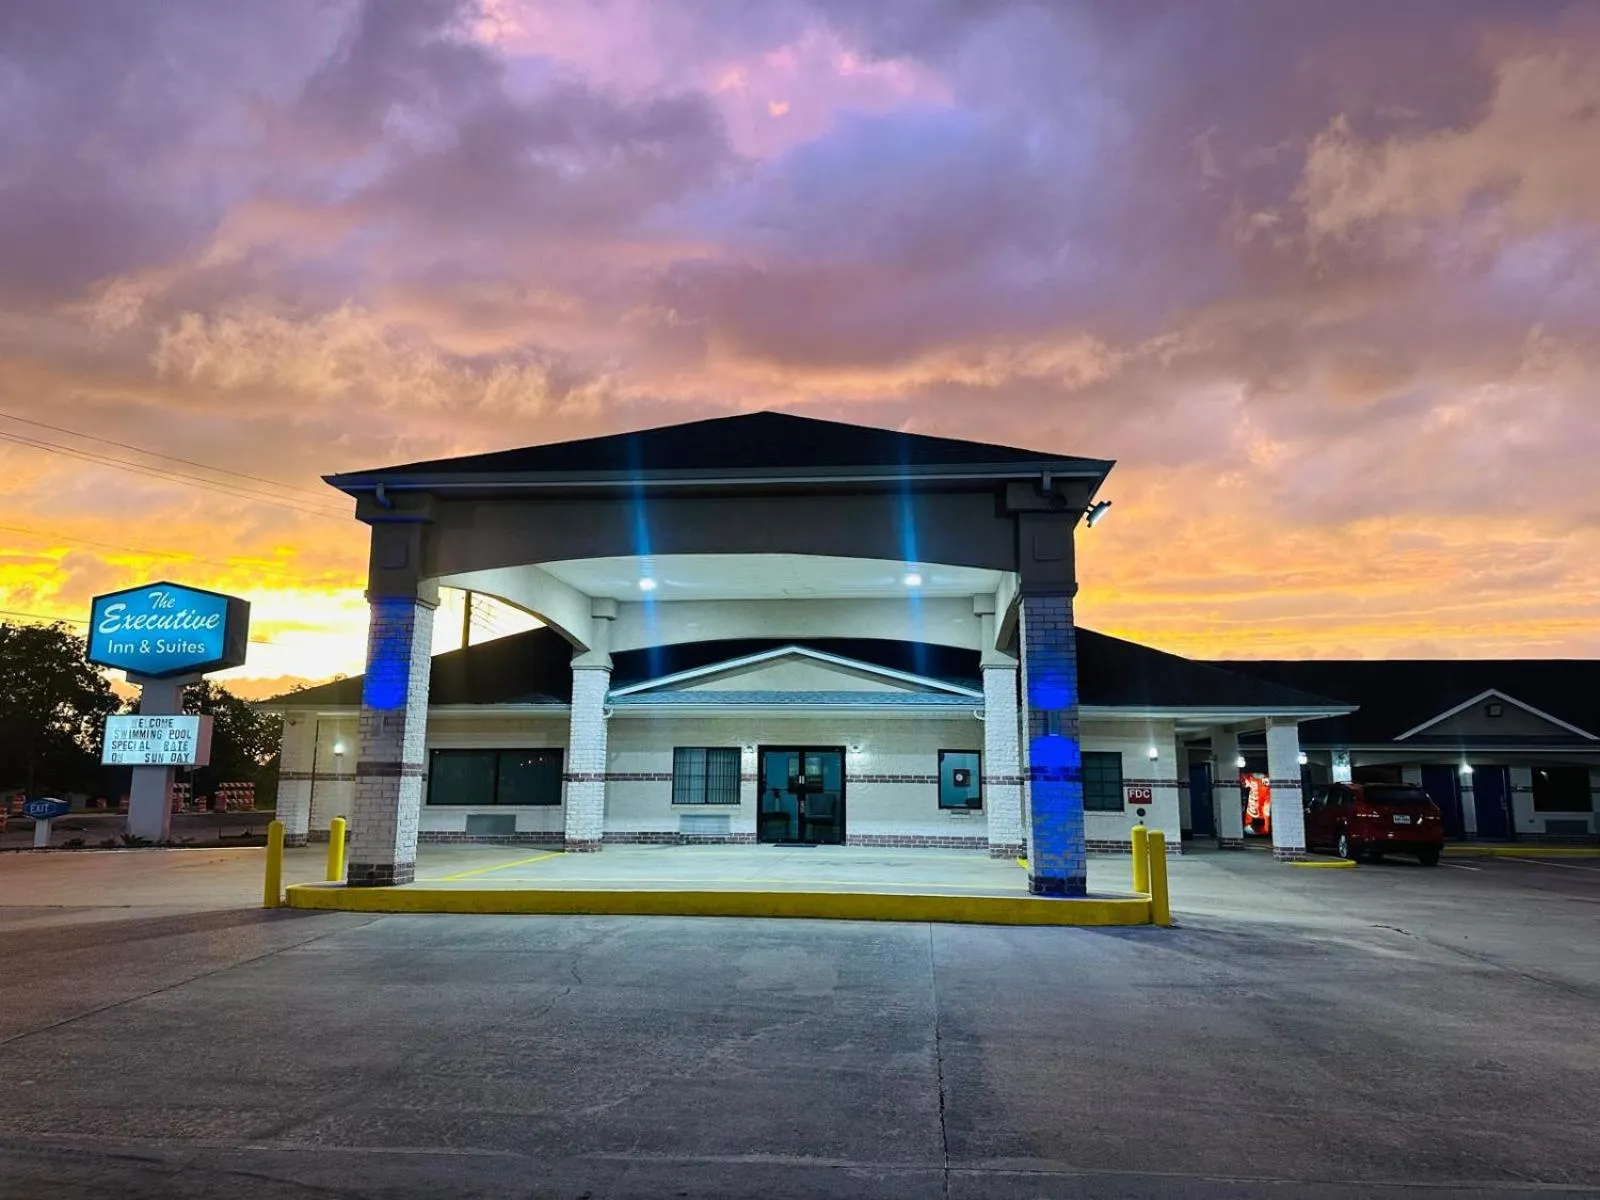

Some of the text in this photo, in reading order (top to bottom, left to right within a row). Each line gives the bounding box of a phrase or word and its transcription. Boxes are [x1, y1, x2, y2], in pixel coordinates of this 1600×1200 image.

[148, 591, 176, 609] The
[98, 603, 220, 634] Executive
[108, 638, 205, 653] Inn & Suites
[168, 728, 192, 740] POOL
[111, 740, 151, 750] SPECIAL
[1129, 789, 1151, 799] FDC
[30, 804, 49, 813] EXIT
